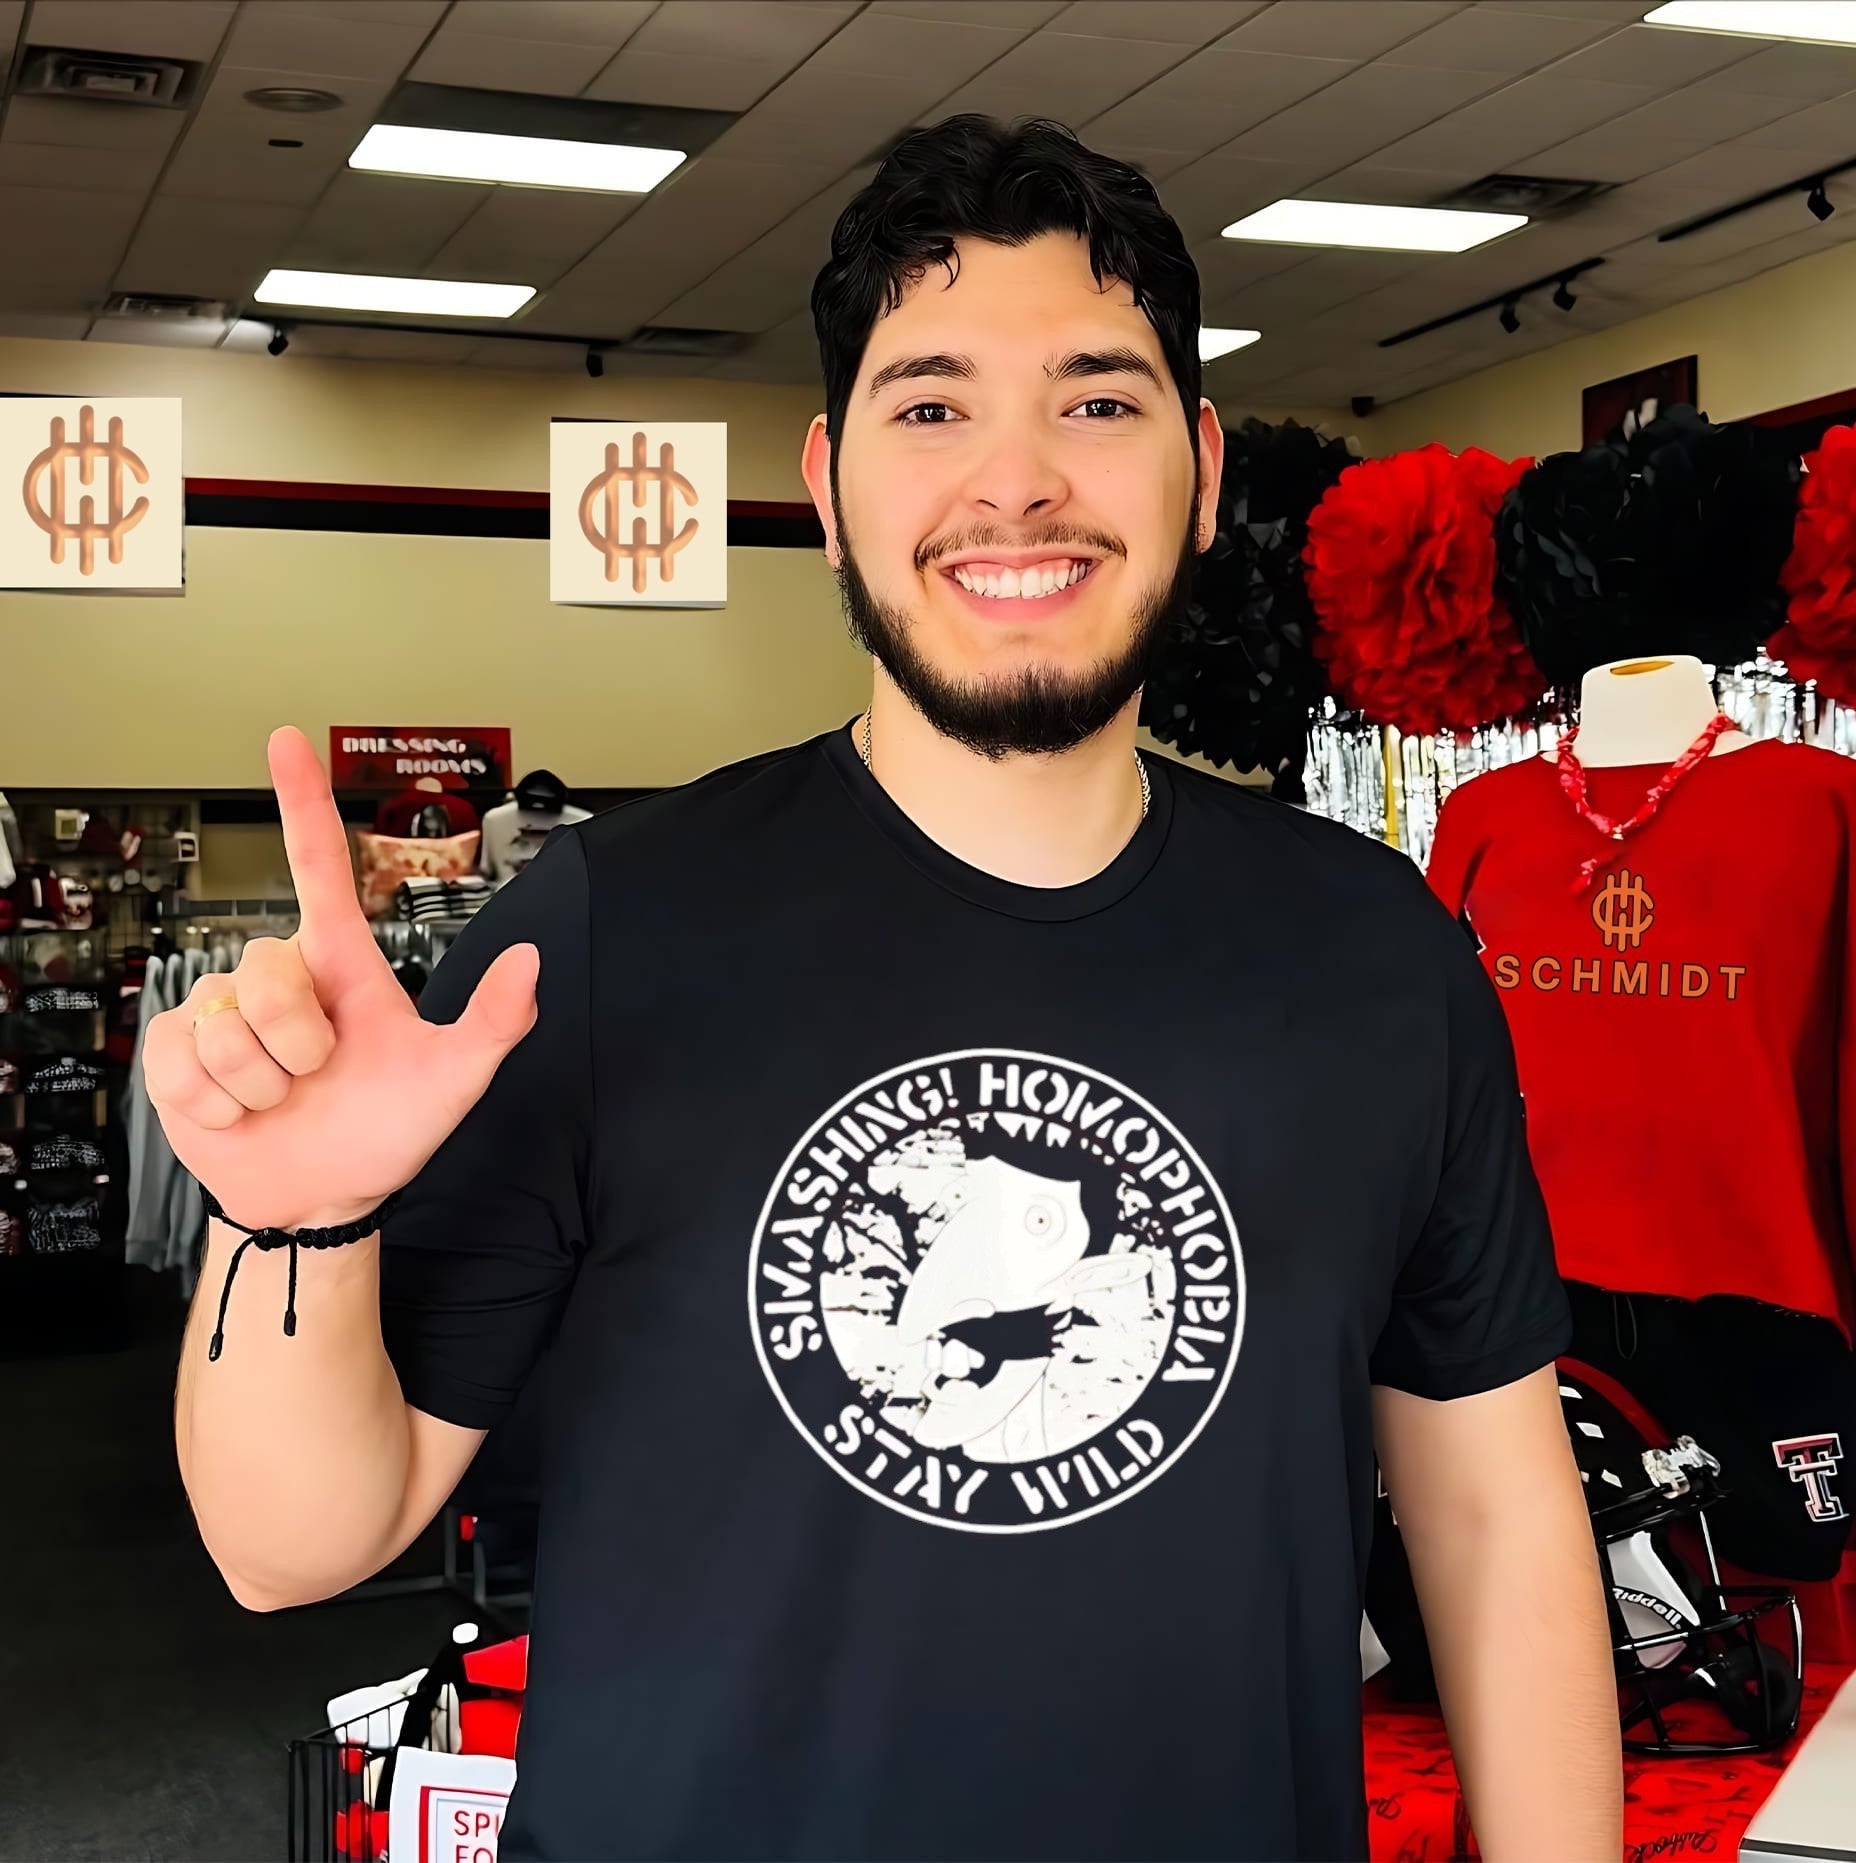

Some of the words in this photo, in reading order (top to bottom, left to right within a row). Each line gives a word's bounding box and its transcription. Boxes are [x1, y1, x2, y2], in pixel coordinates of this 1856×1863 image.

[341, 737, 466, 753] DRESSING
[396, 758, 487, 775] ROOMS
[1493, 954, 1747, 1001] SCHMIDT
[763, 1067, 959, 1361] SMASHING!
[979, 1062, 1231, 1383] HOMOPHOBIA
[823, 1403, 989, 1515] STAY
[1011, 1418, 1165, 1515] WILD
